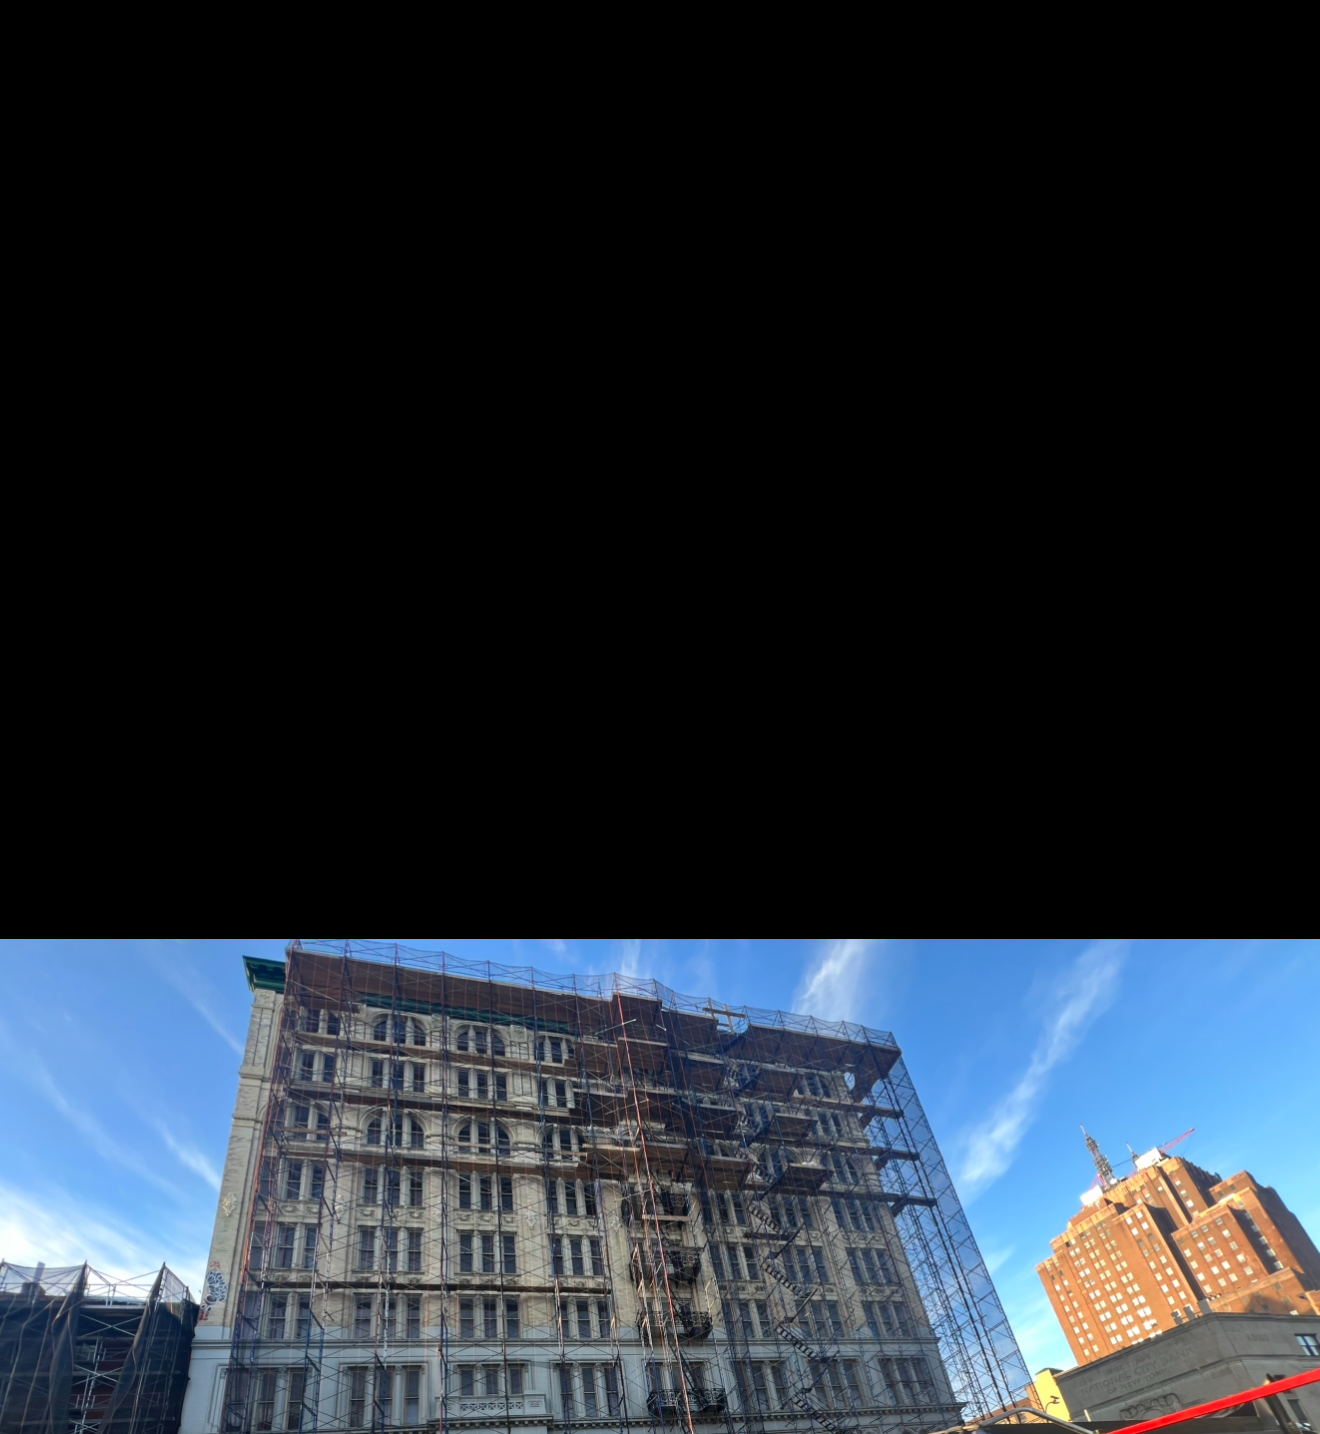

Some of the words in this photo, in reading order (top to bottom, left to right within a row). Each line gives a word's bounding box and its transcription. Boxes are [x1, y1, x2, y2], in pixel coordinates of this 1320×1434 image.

[1080, 1371, 1132, 1396] NATIONAL
[1134, 1360, 1156, 1375] CITY
[1160, 1346, 1195, 1366] BANK
[1119, 1377, 1140, 1391] NEW
[1142, 1367, 1170, 1382] YORK
